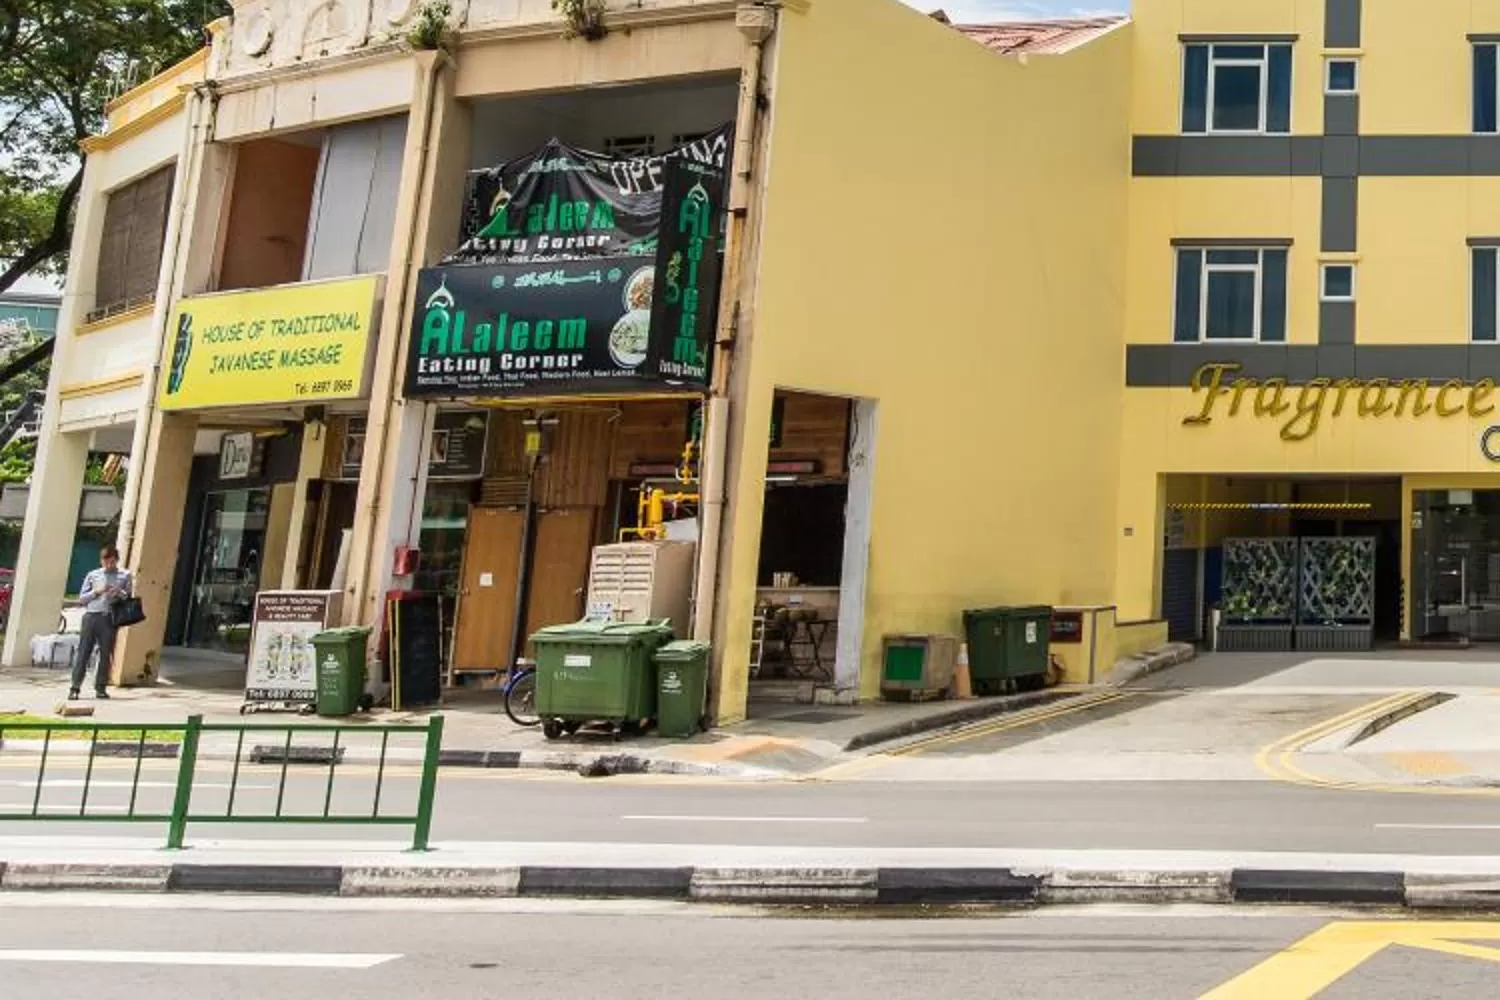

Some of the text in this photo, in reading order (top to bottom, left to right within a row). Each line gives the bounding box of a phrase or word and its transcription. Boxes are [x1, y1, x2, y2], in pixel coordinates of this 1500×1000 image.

[202, 311, 361, 344] HOUSE OF TRADITIONAL
[209, 343, 343, 374] JAVANESE MASSAGE
[417, 352, 585, 374] Eating Corner
[1181, 360, 1496, 441] Fragrance
